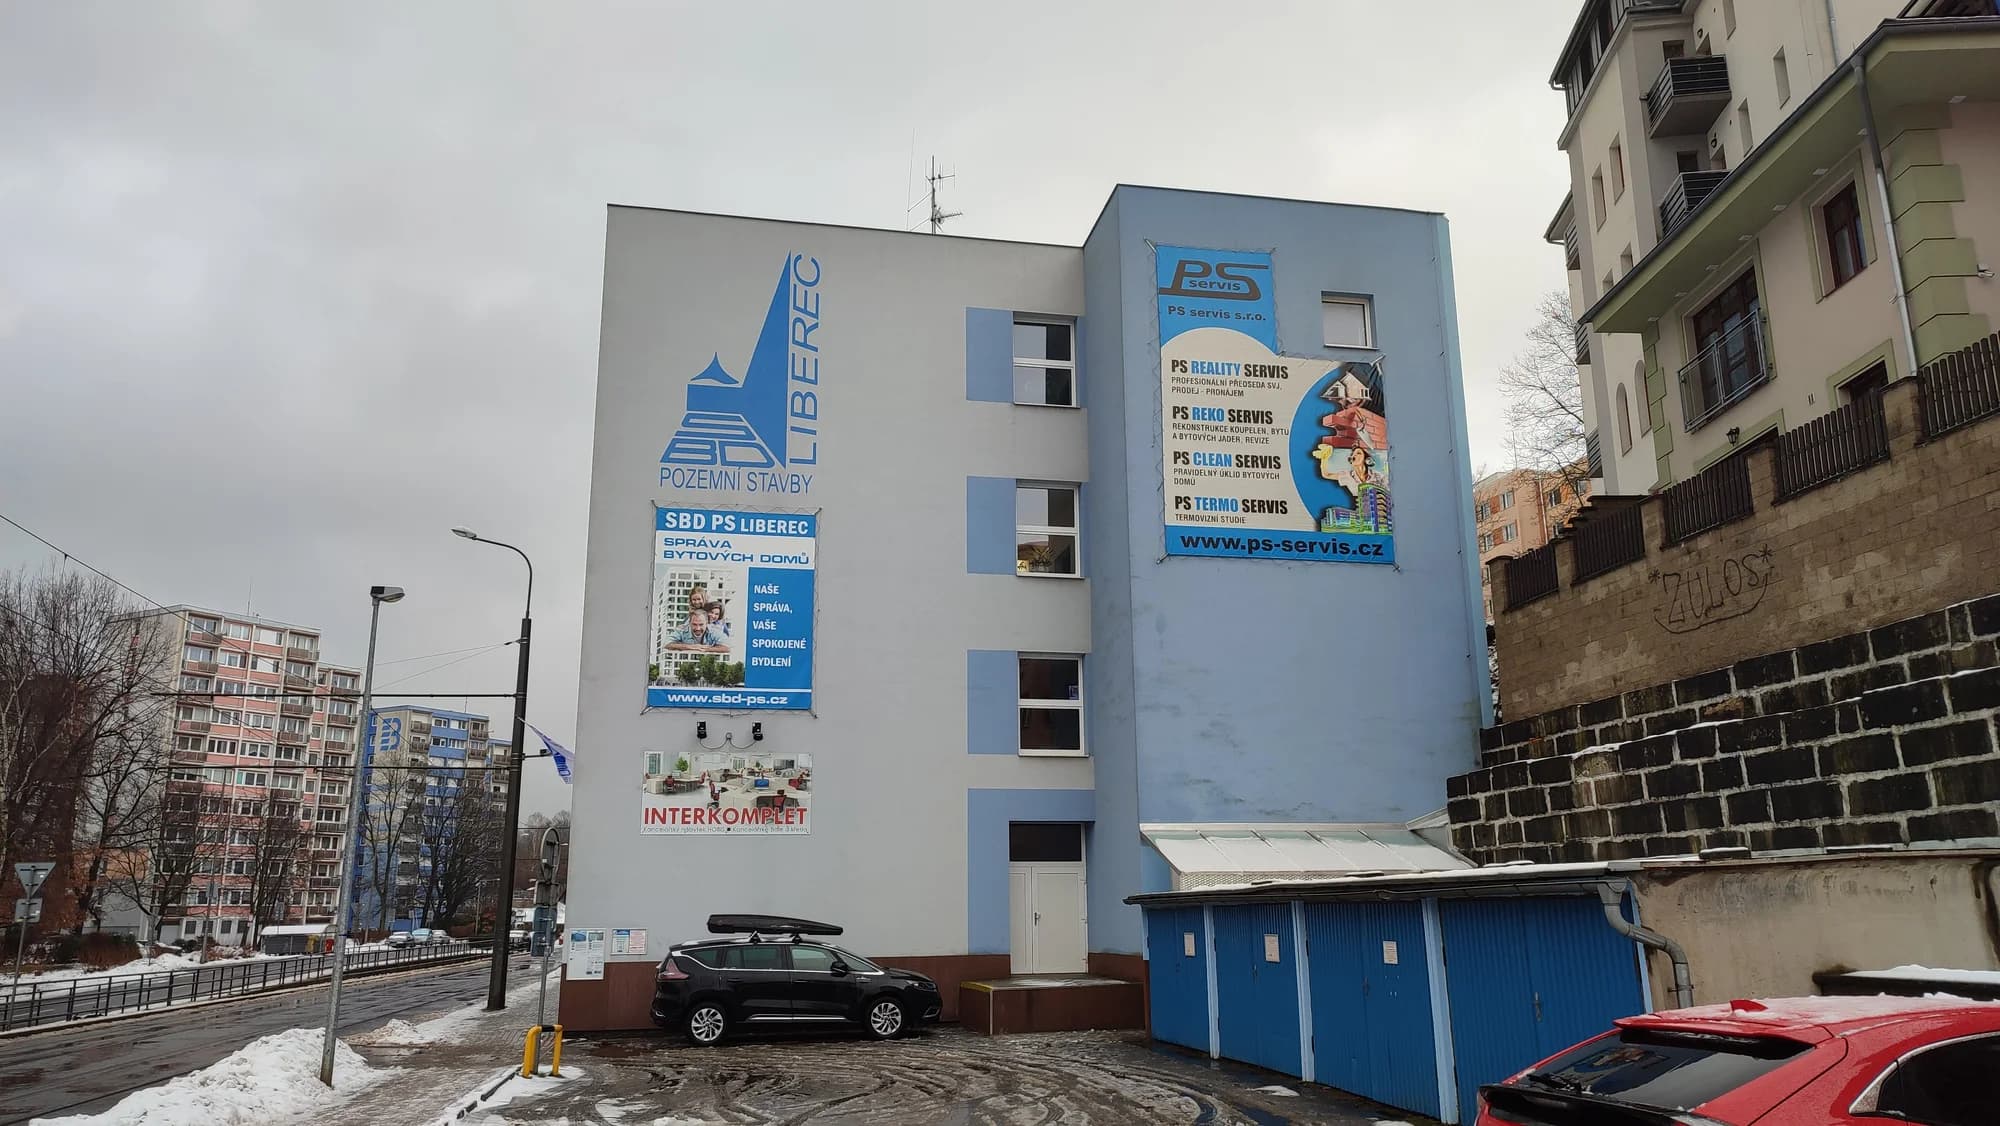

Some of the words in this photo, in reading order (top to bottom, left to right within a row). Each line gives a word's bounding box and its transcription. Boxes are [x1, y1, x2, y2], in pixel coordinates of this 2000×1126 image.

[1159, 259, 1269, 301] PS
[1189, 280, 1241, 291] servis
[1168, 305, 1186, 316] PS
[1190, 309, 1231, 320] servis
[1235, 312, 1266, 321] s.r.o.
[789, 253, 821, 466] LIBEREC
[1171, 359, 1188, 374] PS
[1191, 360, 1241, 376] REALITY
[1244, 363, 1289, 379] SERVIS
[1171, 386, 1199, 395] PRODEJ
[1172, 405, 1189, 420] PS
[1192, 406, 1225, 422] REKO
[1228, 408, 1273, 424] SERVIS
[1172, 422, 1228, 433] REKONSTRUKCE
[1172, 432, 1178, 440] A
[1245, 436, 1270, 445] REVIZE
[1173, 451, 1190, 465] PS
[1193, 451, 1232, 467] CLEAN
[1235, 454, 1281, 470] SERVIS
[660, 466, 741, 490] POZEMNÍ
[747, 471, 813, 494] STAVBY
[1175, 495, 1191, 510] PS
[1194, 496, 1239, 512] TERMO
[1242, 498, 1288, 515] SERVIS
[665, 511, 706, 530] SBD
[711, 513, 736, 532] PS
[740, 518, 809, 535] LIBEREC
[1220, 515, 1246, 524] STUDIE
[663, 536, 732, 549] SPRÁVA
[1180, 534, 1384, 557] www.ps-servis.cz
[663, 550, 754, 563] BYTOVÝCH
[760, 552, 809, 565] DOMŮ
[754, 584, 780, 595] NAŠE
[753, 600, 793, 614] SPRÁVA,
[752, 620, 777, 631] VAŠE
[752, 638, 806, 649] SPOKOJENÉ
[751, 655, 792, 667] BYDLENÍ
[667, 693, 788, 706] www.sbd-ps.cz
[643, 807, 808, 825] INTERKOMPLET
